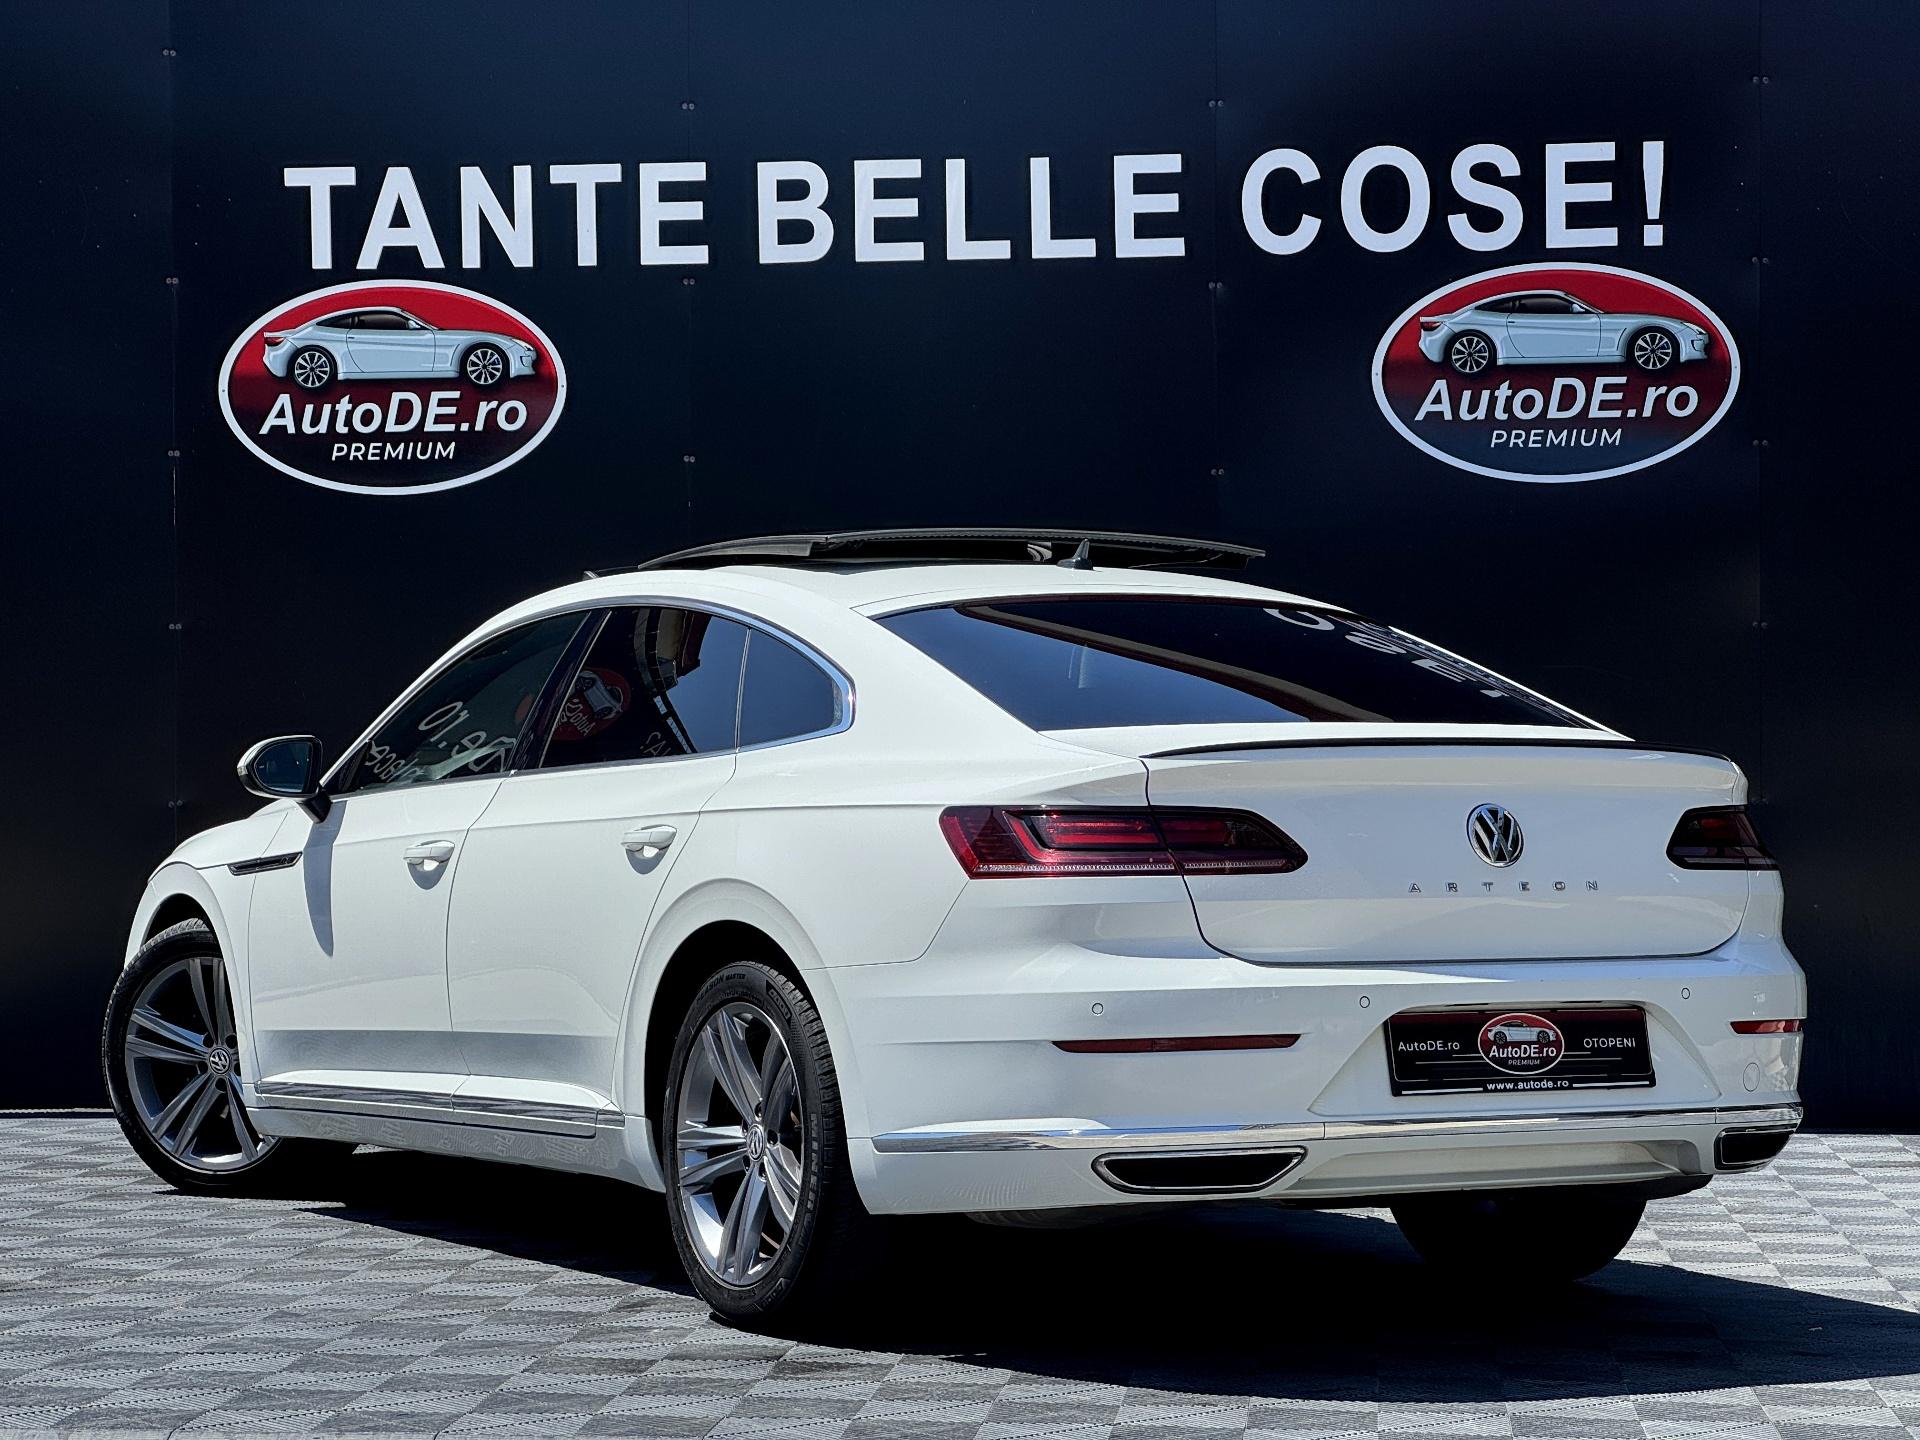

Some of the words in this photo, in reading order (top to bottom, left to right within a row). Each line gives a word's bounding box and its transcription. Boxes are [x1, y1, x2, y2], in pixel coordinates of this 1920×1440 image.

[283, 161, 709, 270] TANTE
[756, 153, 1187, 264] BELLE
[1241, 140, 1665, 255] COSE!
[1414, 376, 1700, 421] AutoDE.ro
[258, 390, 528, 435] AutoDE.ro
[1490, 428, 1623, 448] PREMIUM
[331, 441, 457, 461] PREMIUM
[1408, 880, 1599, 893] ARTEON
[1398, 1040, 1460, 1052] AutoDE.ro
[1488, 1044, 1557, 1058] AutoDE.ro
[1583, 1037, 1636, 1049] OTOPENI
[1486, 1079, 1570, 1091] www.autode.ro
